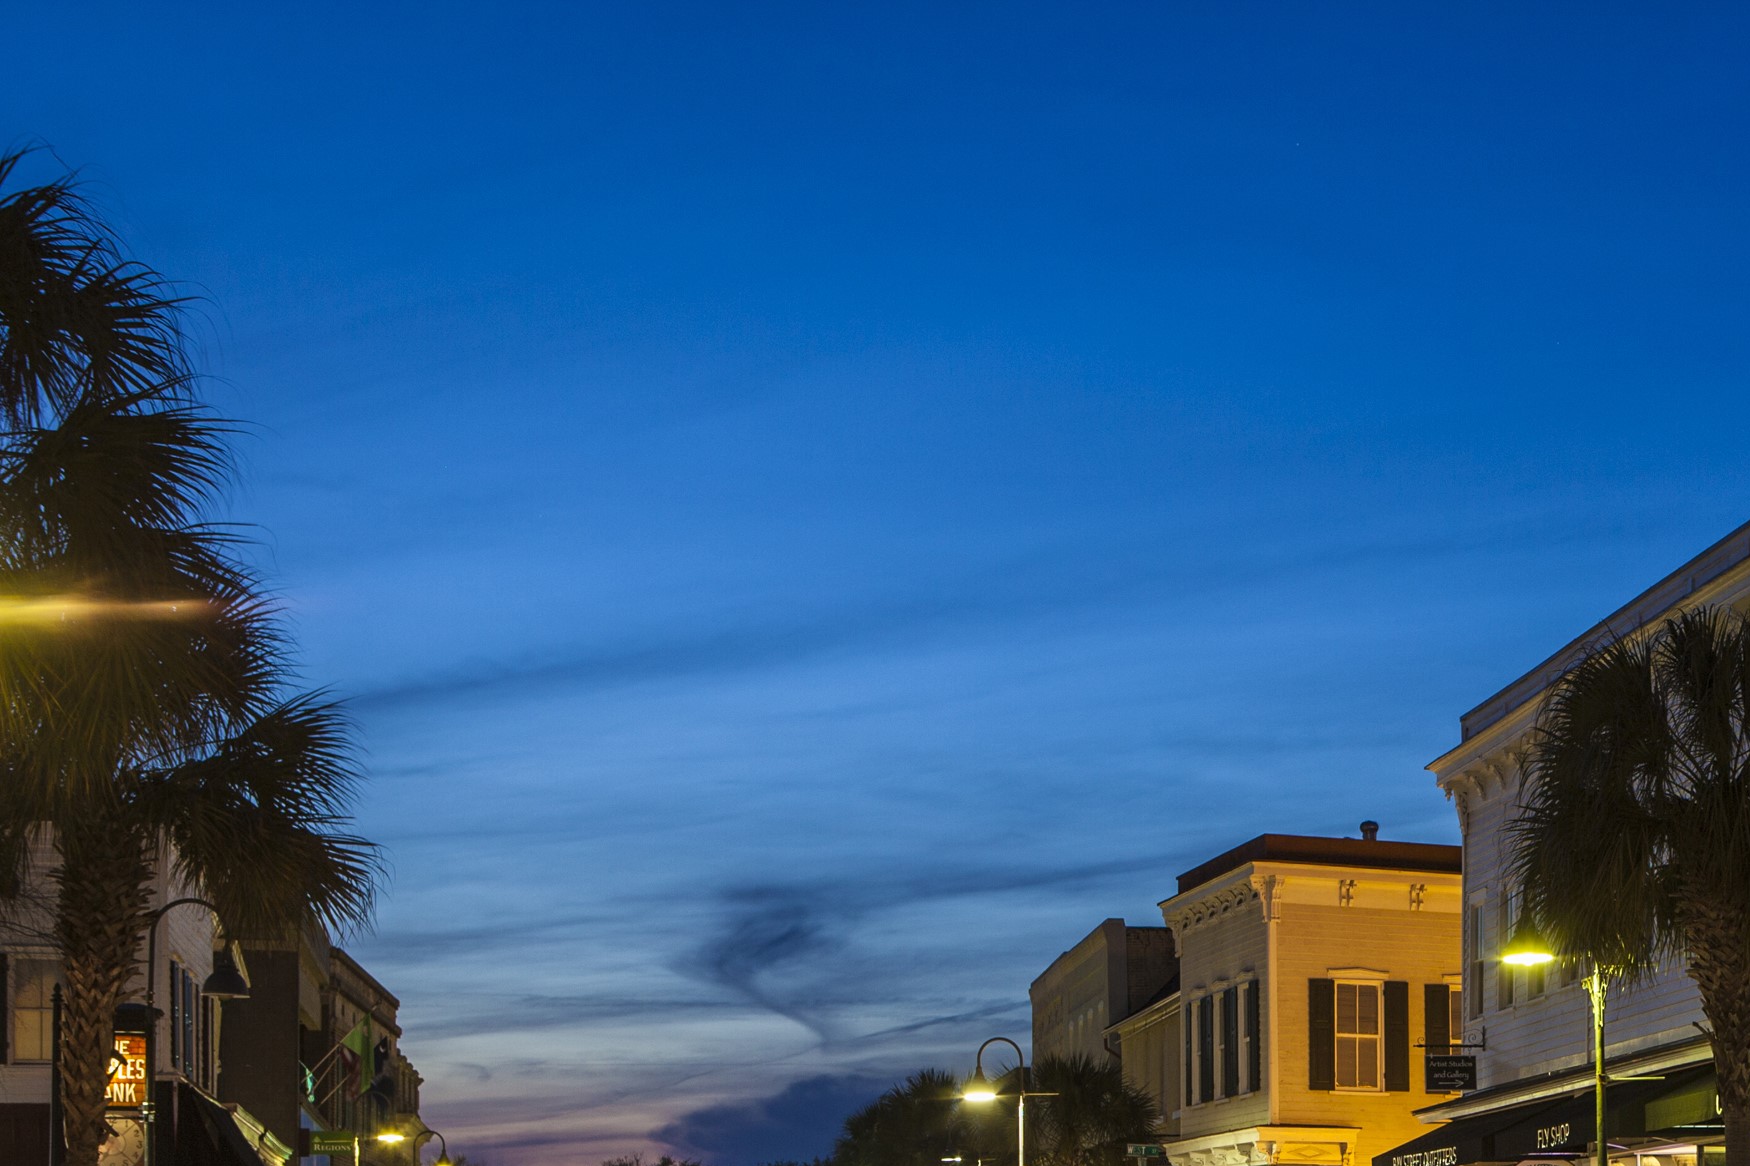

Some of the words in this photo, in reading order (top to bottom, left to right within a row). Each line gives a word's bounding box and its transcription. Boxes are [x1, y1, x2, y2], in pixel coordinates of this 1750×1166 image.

[1446, 1071, 1469, 1080] Gallery
[1537, 1128, 1550, 1149] FLY
[1550, 1123, 1570, 1147] SHOP
[1127, 1145, 1146, 1155] WEST
